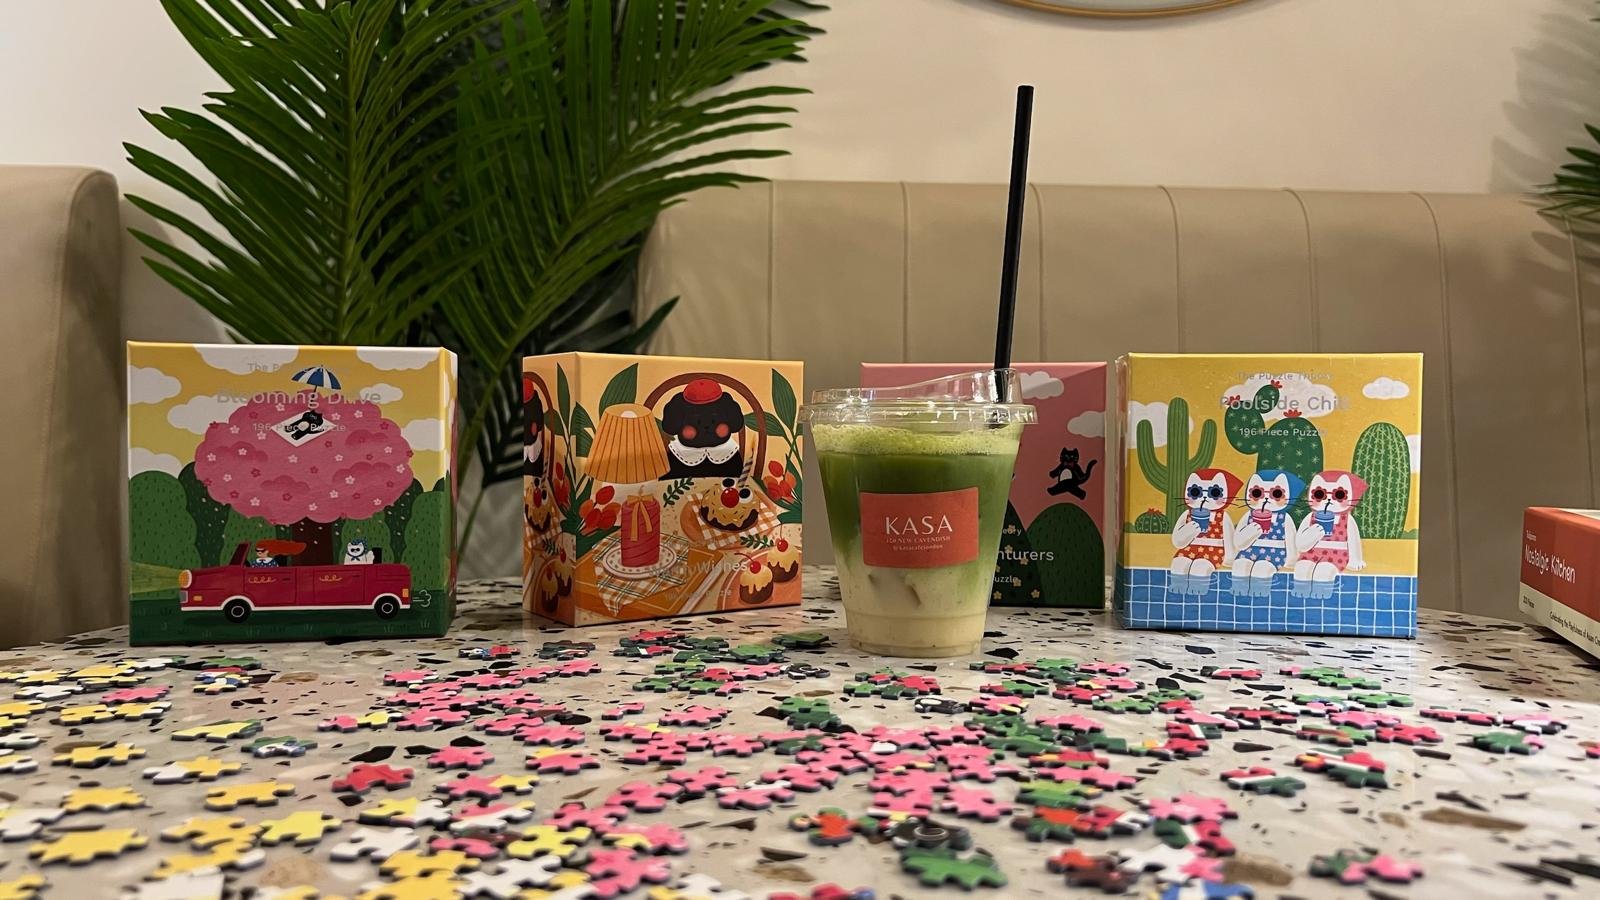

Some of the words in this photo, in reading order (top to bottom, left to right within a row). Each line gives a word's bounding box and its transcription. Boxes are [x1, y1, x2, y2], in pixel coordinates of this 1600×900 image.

[1259, 372, 1293, 381] Puzzle
[1219, 396, 1299, 411] Poolside
[253, 423, 271, 432] 196
[1239, 428, 1257, 437] 196
[1261, 428, 1289, 437] Piece
[885, 514, 953, 535] KASA
[696, 560, 747, 573] Wihes
[1525, 545, 1549, 575] Nostalgic
[1550, 555, 1576, 583] Kitchen
